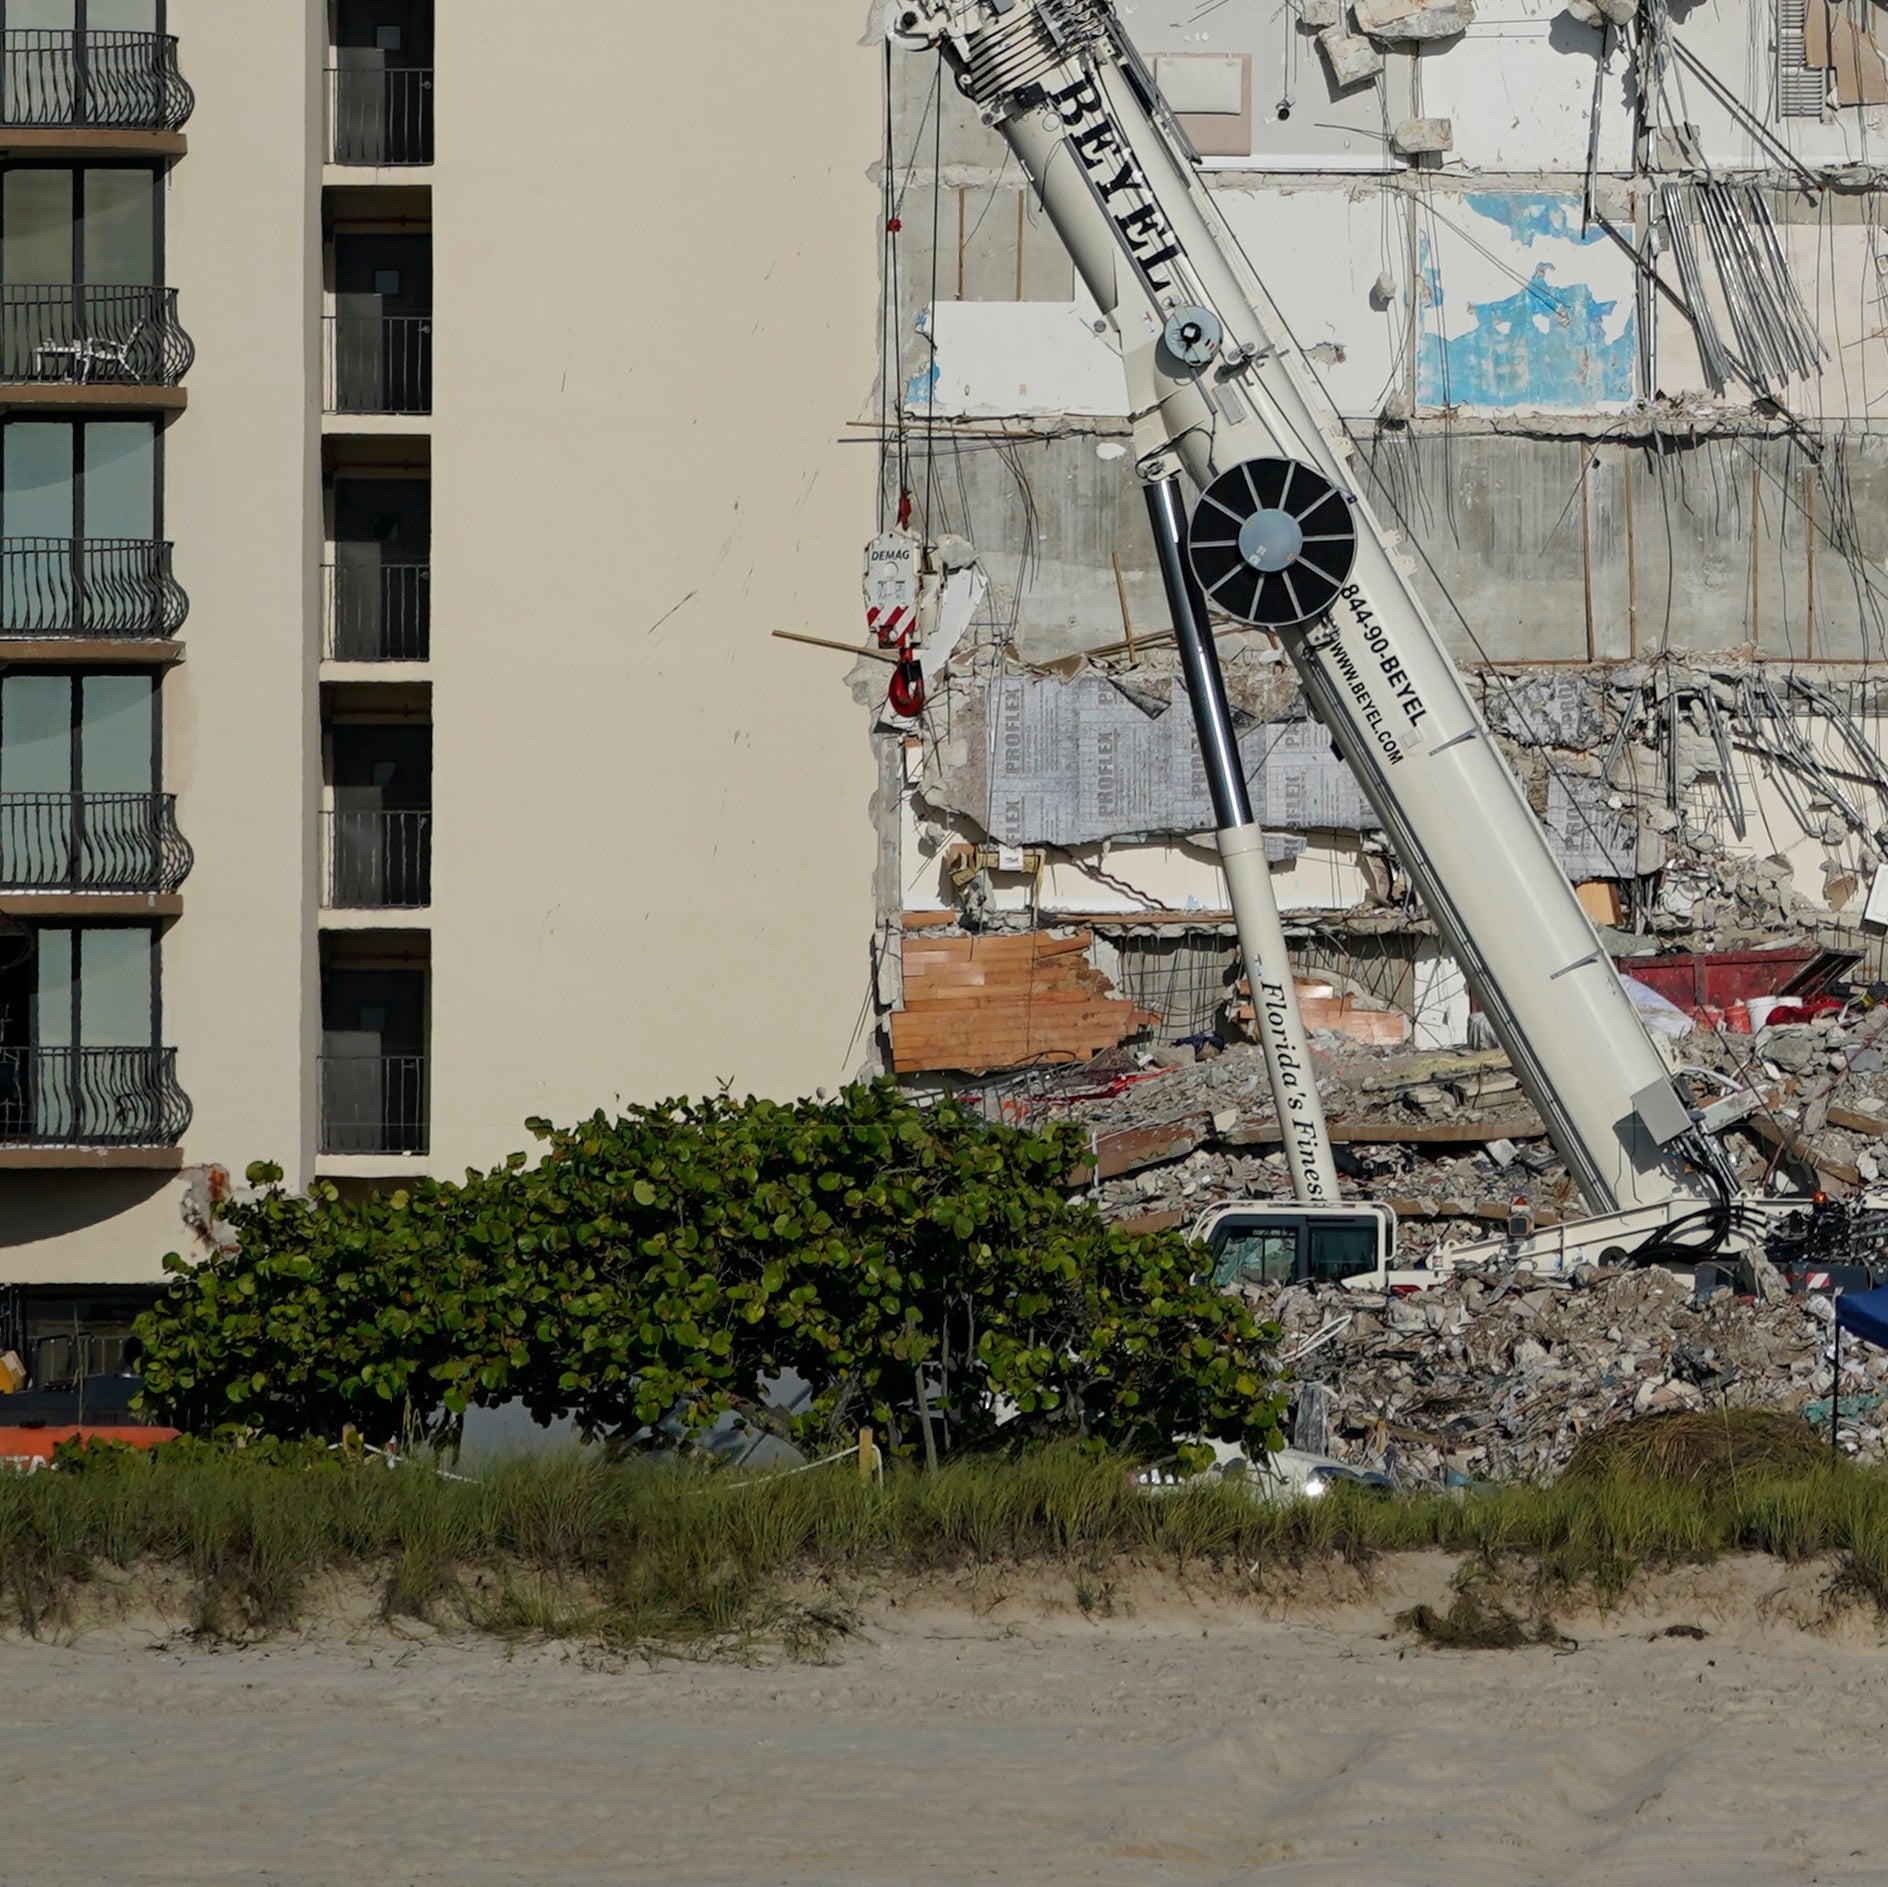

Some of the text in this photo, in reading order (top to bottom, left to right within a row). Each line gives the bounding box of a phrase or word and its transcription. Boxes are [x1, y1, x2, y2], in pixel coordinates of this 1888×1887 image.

[1051, 73, 1187, 291] BEYEL
[871, 549, 910, 561] DEMAG
[1329, 641, 1404, 767] WWW.BEYEL.COM
[1341, 583, 1428, 728] 844-90-BEYEL
[1005, 689, 1021, 775] PROFLEX
[1098, 732, 1114, 817] PROFLEX
[1260, 981, 1306, 1110] Florida's
